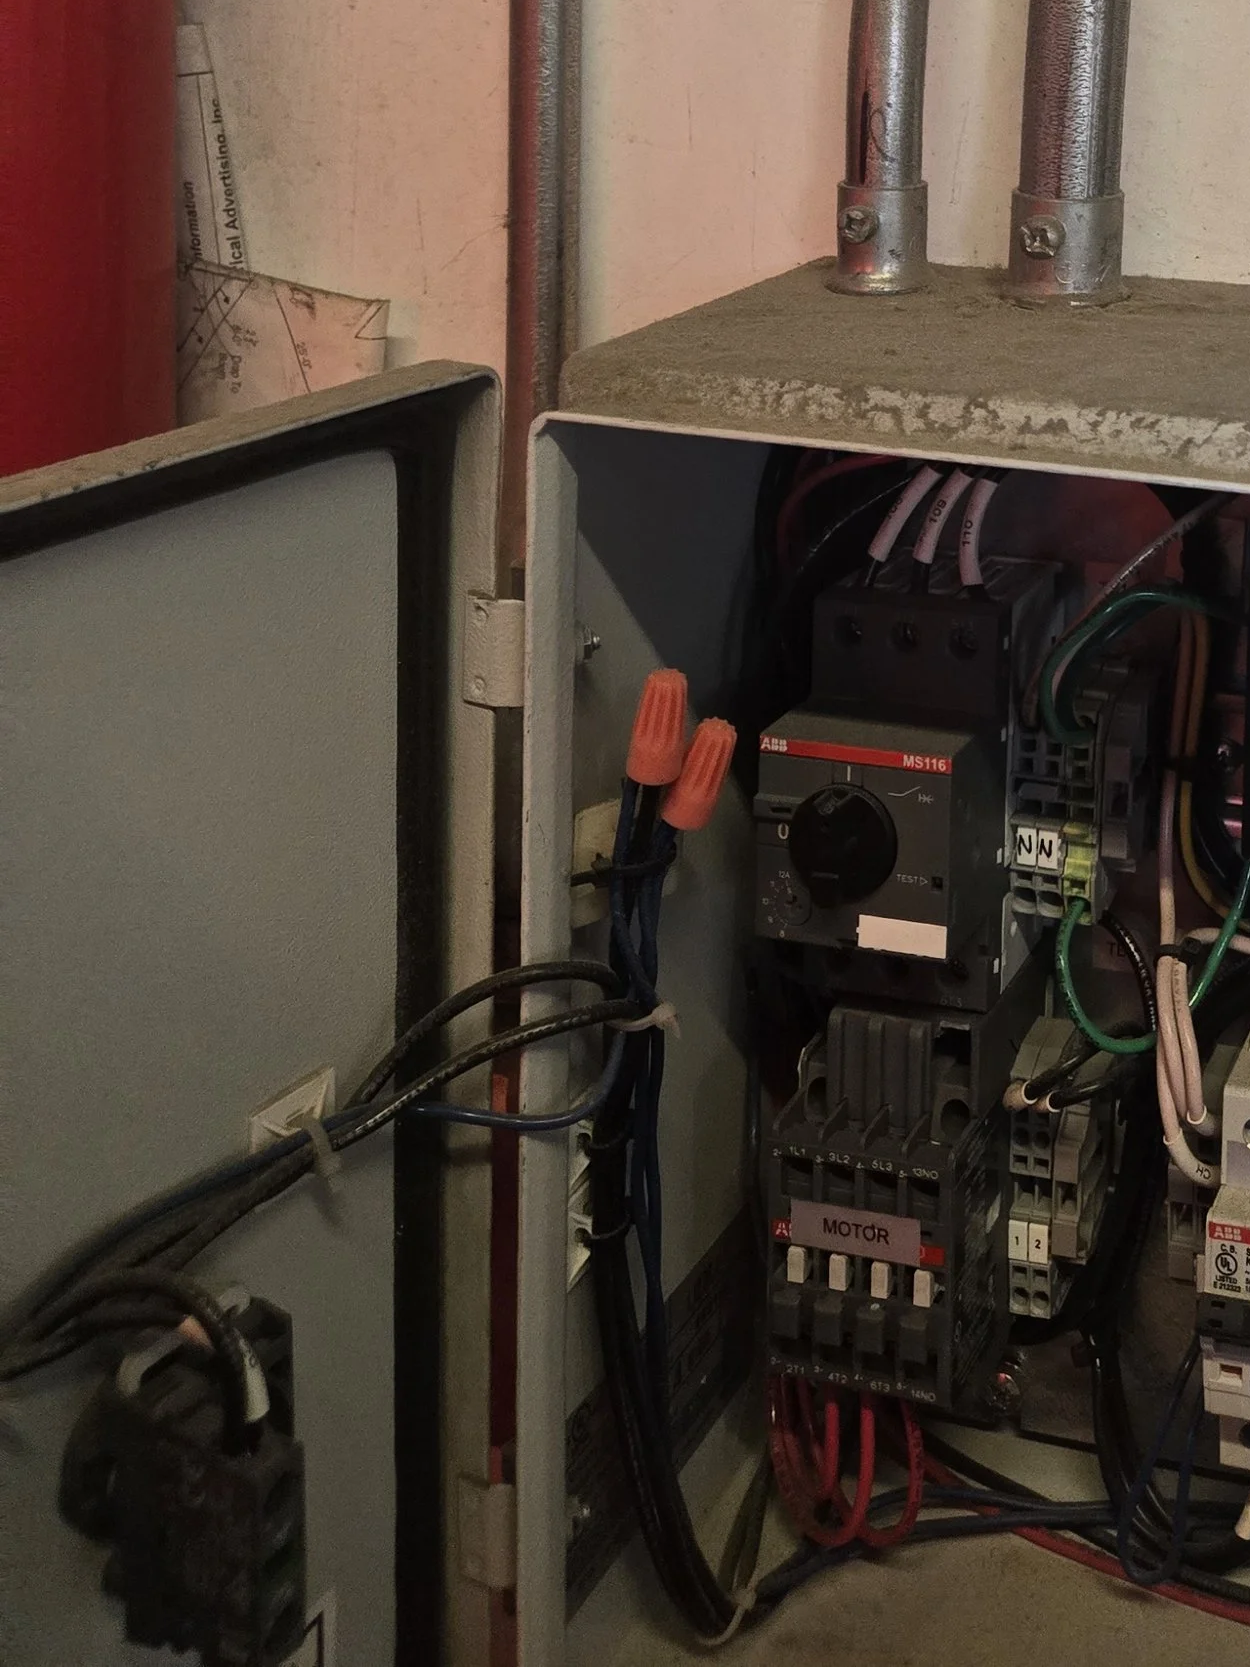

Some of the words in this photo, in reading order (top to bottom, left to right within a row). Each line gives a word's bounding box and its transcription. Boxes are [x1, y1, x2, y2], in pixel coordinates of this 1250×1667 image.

[183, 181, 203, 261] nformation
[962, 520, 973, 546] 110
[760, 736, 788, 753] ABB
[903, 756, 947, 772] MS116
[1017, 835, 1032, 856] N
[1038, 839, 1054, 860] N
[896, 874, 919, 885] TEST
[789, 1145, 806, 1157] 1L1
[827, 1152, 851, 1165] 3L2
[871, 1159, 894, 1173] 5L3
[823, 1217, 890, 1245] MOTOR
[1213, 1226, 1242, 1241] ABB
